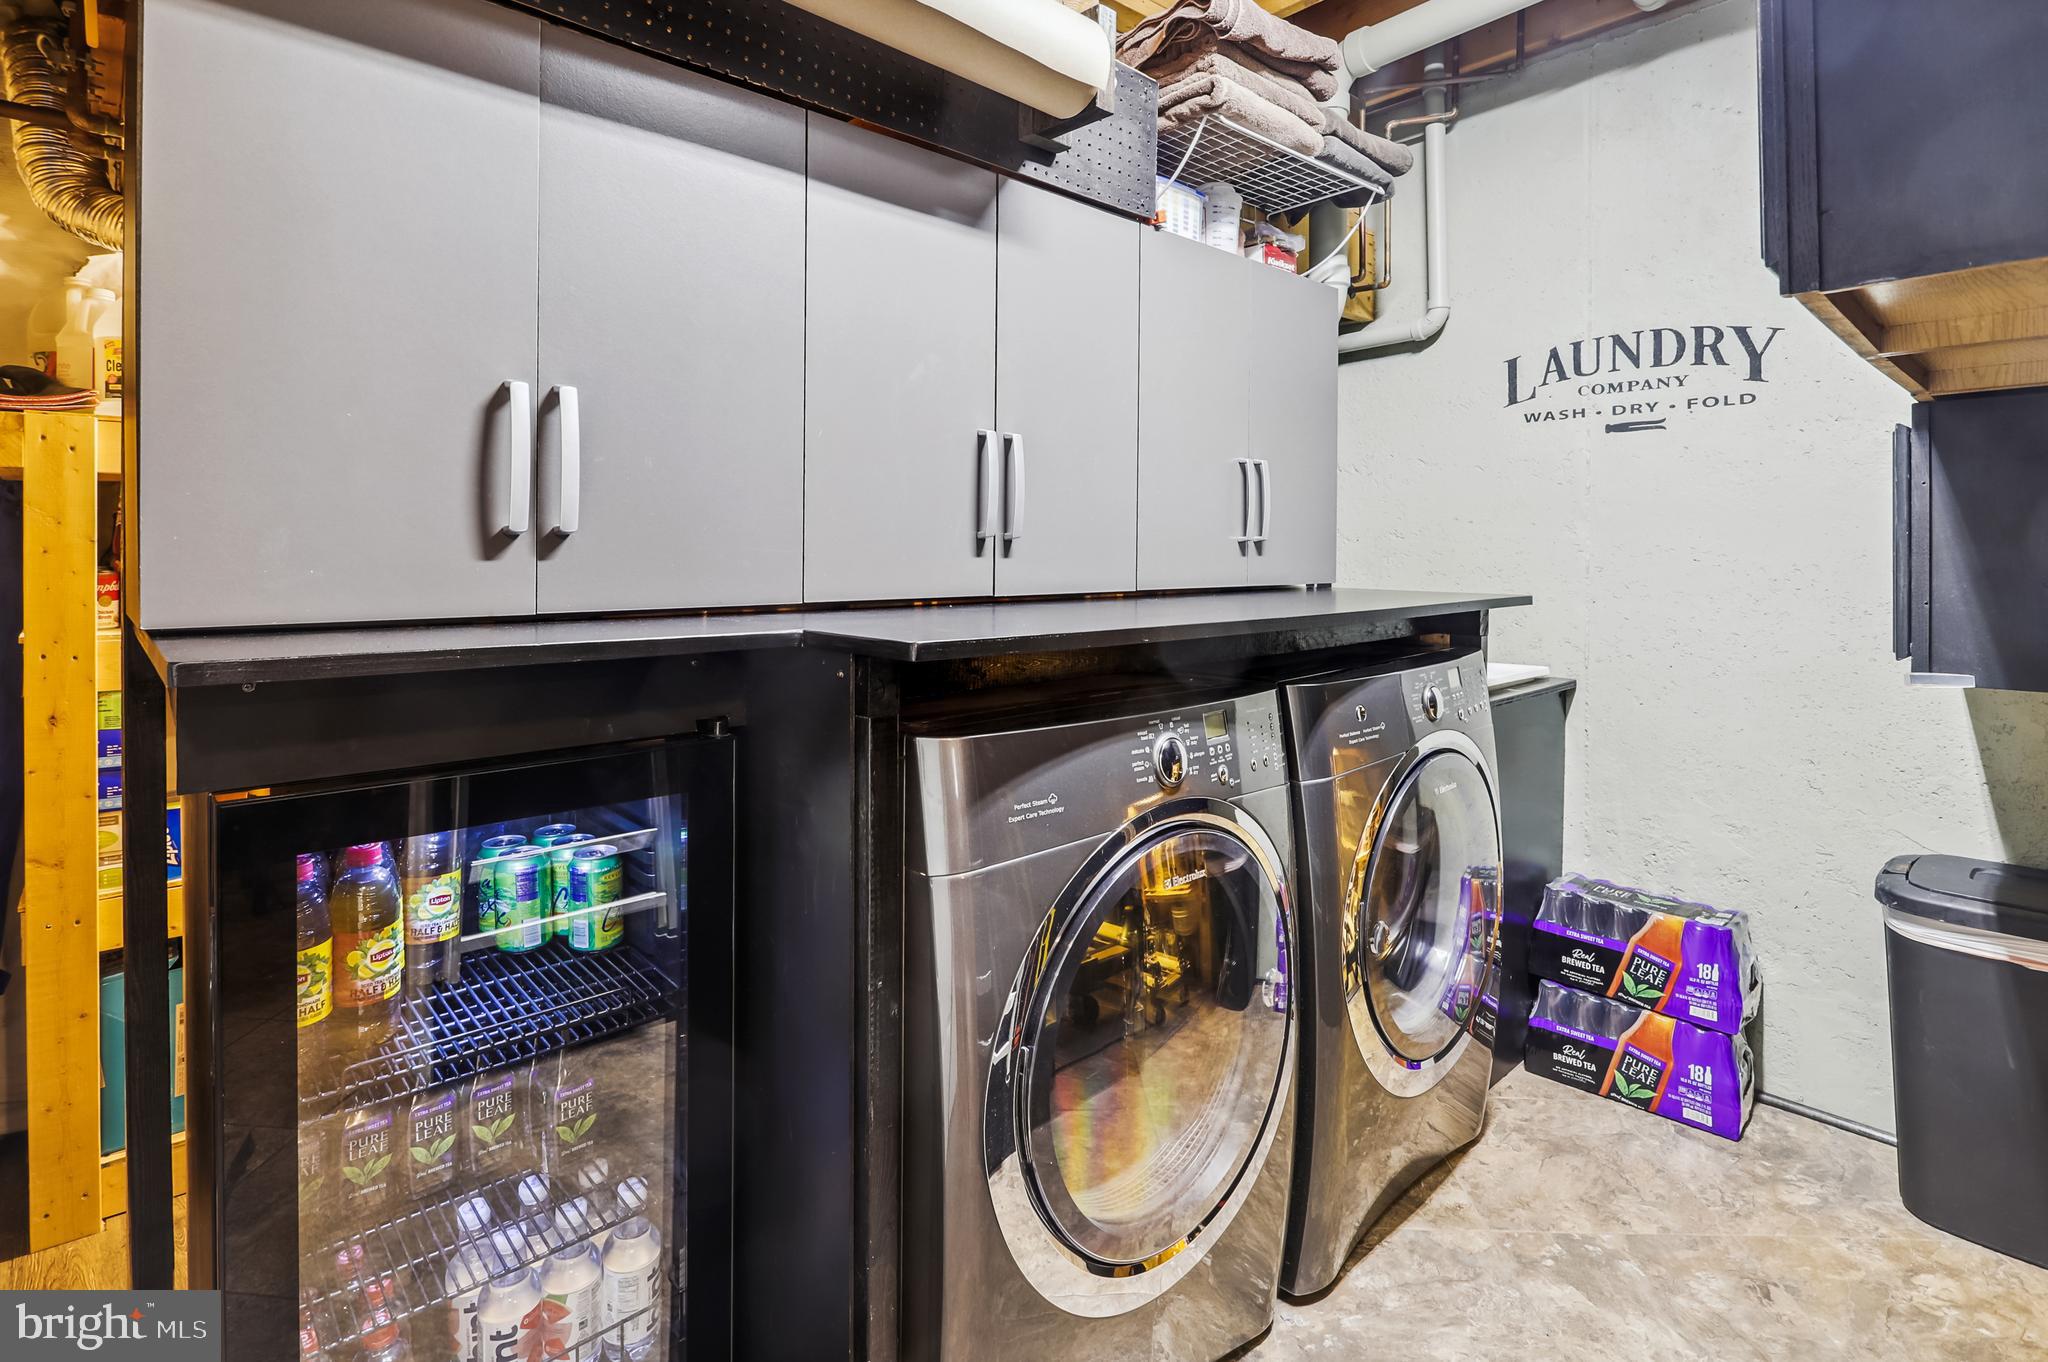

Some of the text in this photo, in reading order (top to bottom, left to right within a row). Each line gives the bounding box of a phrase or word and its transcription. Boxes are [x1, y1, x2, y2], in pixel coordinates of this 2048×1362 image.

[1504, 325, 1785, 408] LAUNDRY
[1578, 374, 1689, 397] COMPANY
[1523, 393, 1757, 424] WASH DRY FOLD
[1014, 799, 1048, 810] Perfect Steam
[1008, 806, 1064, 824] Expert Care Technology
[1172, 869, 1207, 887] Electrolux
[430, 896, 451, 905] Lipton
[1566, 930, 1604, 945] EXTRA SWEET TEA
[372, 948, 394, 961] Lipton
[1572, 948, 1596, 962] Real
[1637, 948, 1650, 958] EXTRA
[1662, 960, 1670, 968] TEA
[1561, 955, 1605, 975] BREWED TEA
[1632, 956, 1668, 979] PURE
[1696, 962, 1712, 980] 18
[1629, 966, 1664, 988] LEAF
[299, 999, 326, 1018] HALF
[1556, 1025, 1595, 1042] EXTRA SWEET TEA
[1553, 1052, 1597, 1072] BREWED TEA
[1562, 1044, 1586, 1060] Real
[1628, 1046, 1641, 1056] EXTRA
[1653, 1059, 1662, 1067] TEA
[1621, 1063, 1656, 1087] LEAF
[1624, 1055, 1659, 1079] PURE
[1688, 1064, 1704, 1082] 18
[478, 1091, 512, 1112] PURE
[478, 1101, 512, 1120] LEAF
[560, 1091, 593, 1112] PURE
[560, 1101, 593, 1122] LEAF
[415, 1111, 453, 1132] PURE
[350, 1130, 389, 1150] PURE
[415, 1122, 453, 1142] LEAF
[349, 1140, 389, 1161] LEAF
